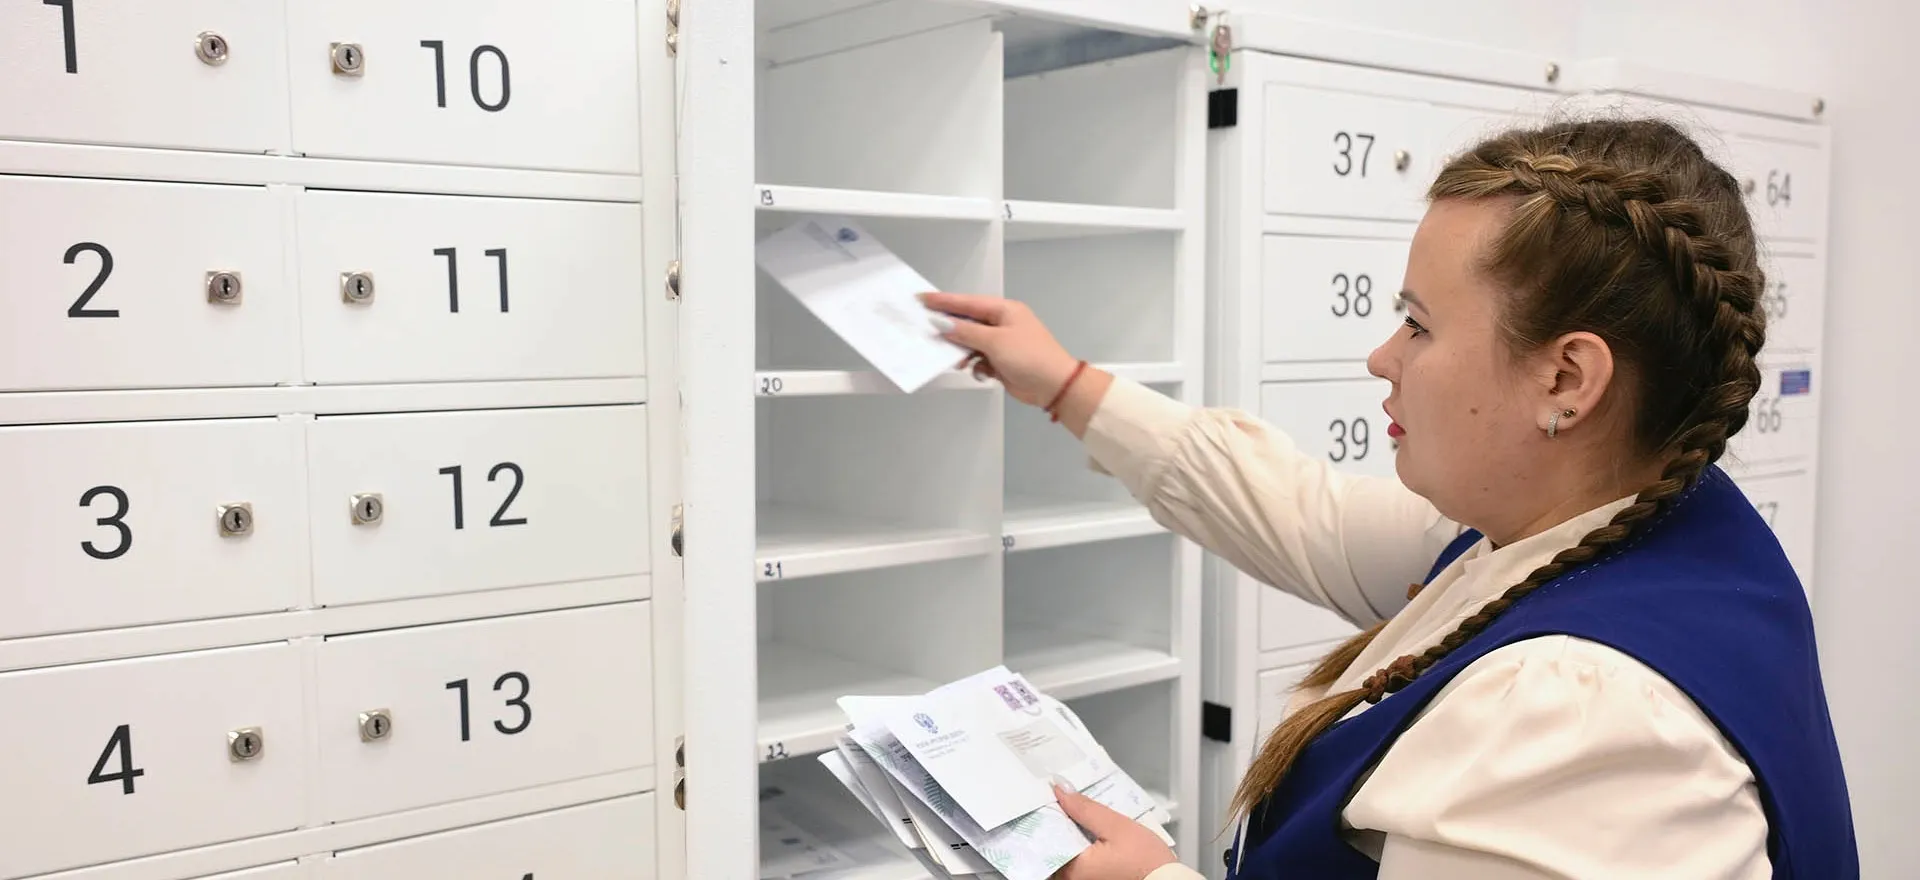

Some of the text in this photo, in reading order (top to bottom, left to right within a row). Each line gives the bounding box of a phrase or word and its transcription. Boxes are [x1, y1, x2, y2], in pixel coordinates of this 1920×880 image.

[42, 0, 78, 74] 1
[420, 40, 511, 112] 10
[1333, 131, 1375, 177] 37
[1767, 171, 1791, 207] 64
[63, 242, 120, 318] 2
[433, 247, 509, 314] 11
[1331, 273, 1372, 318] 38
[761, 377, 783, 396] 20
[1328, 417, 1369, 463] 39
[1757, 397, 1782, 434] 66
[78, 485, 133, 560] 3
[438, 461, 528, 530] 12
[764, 561, 783, 579] 21
[445, 671, 532, 742] 13
[87, 724, 145, 795] 4
[766, 742, 789, 760] 22
